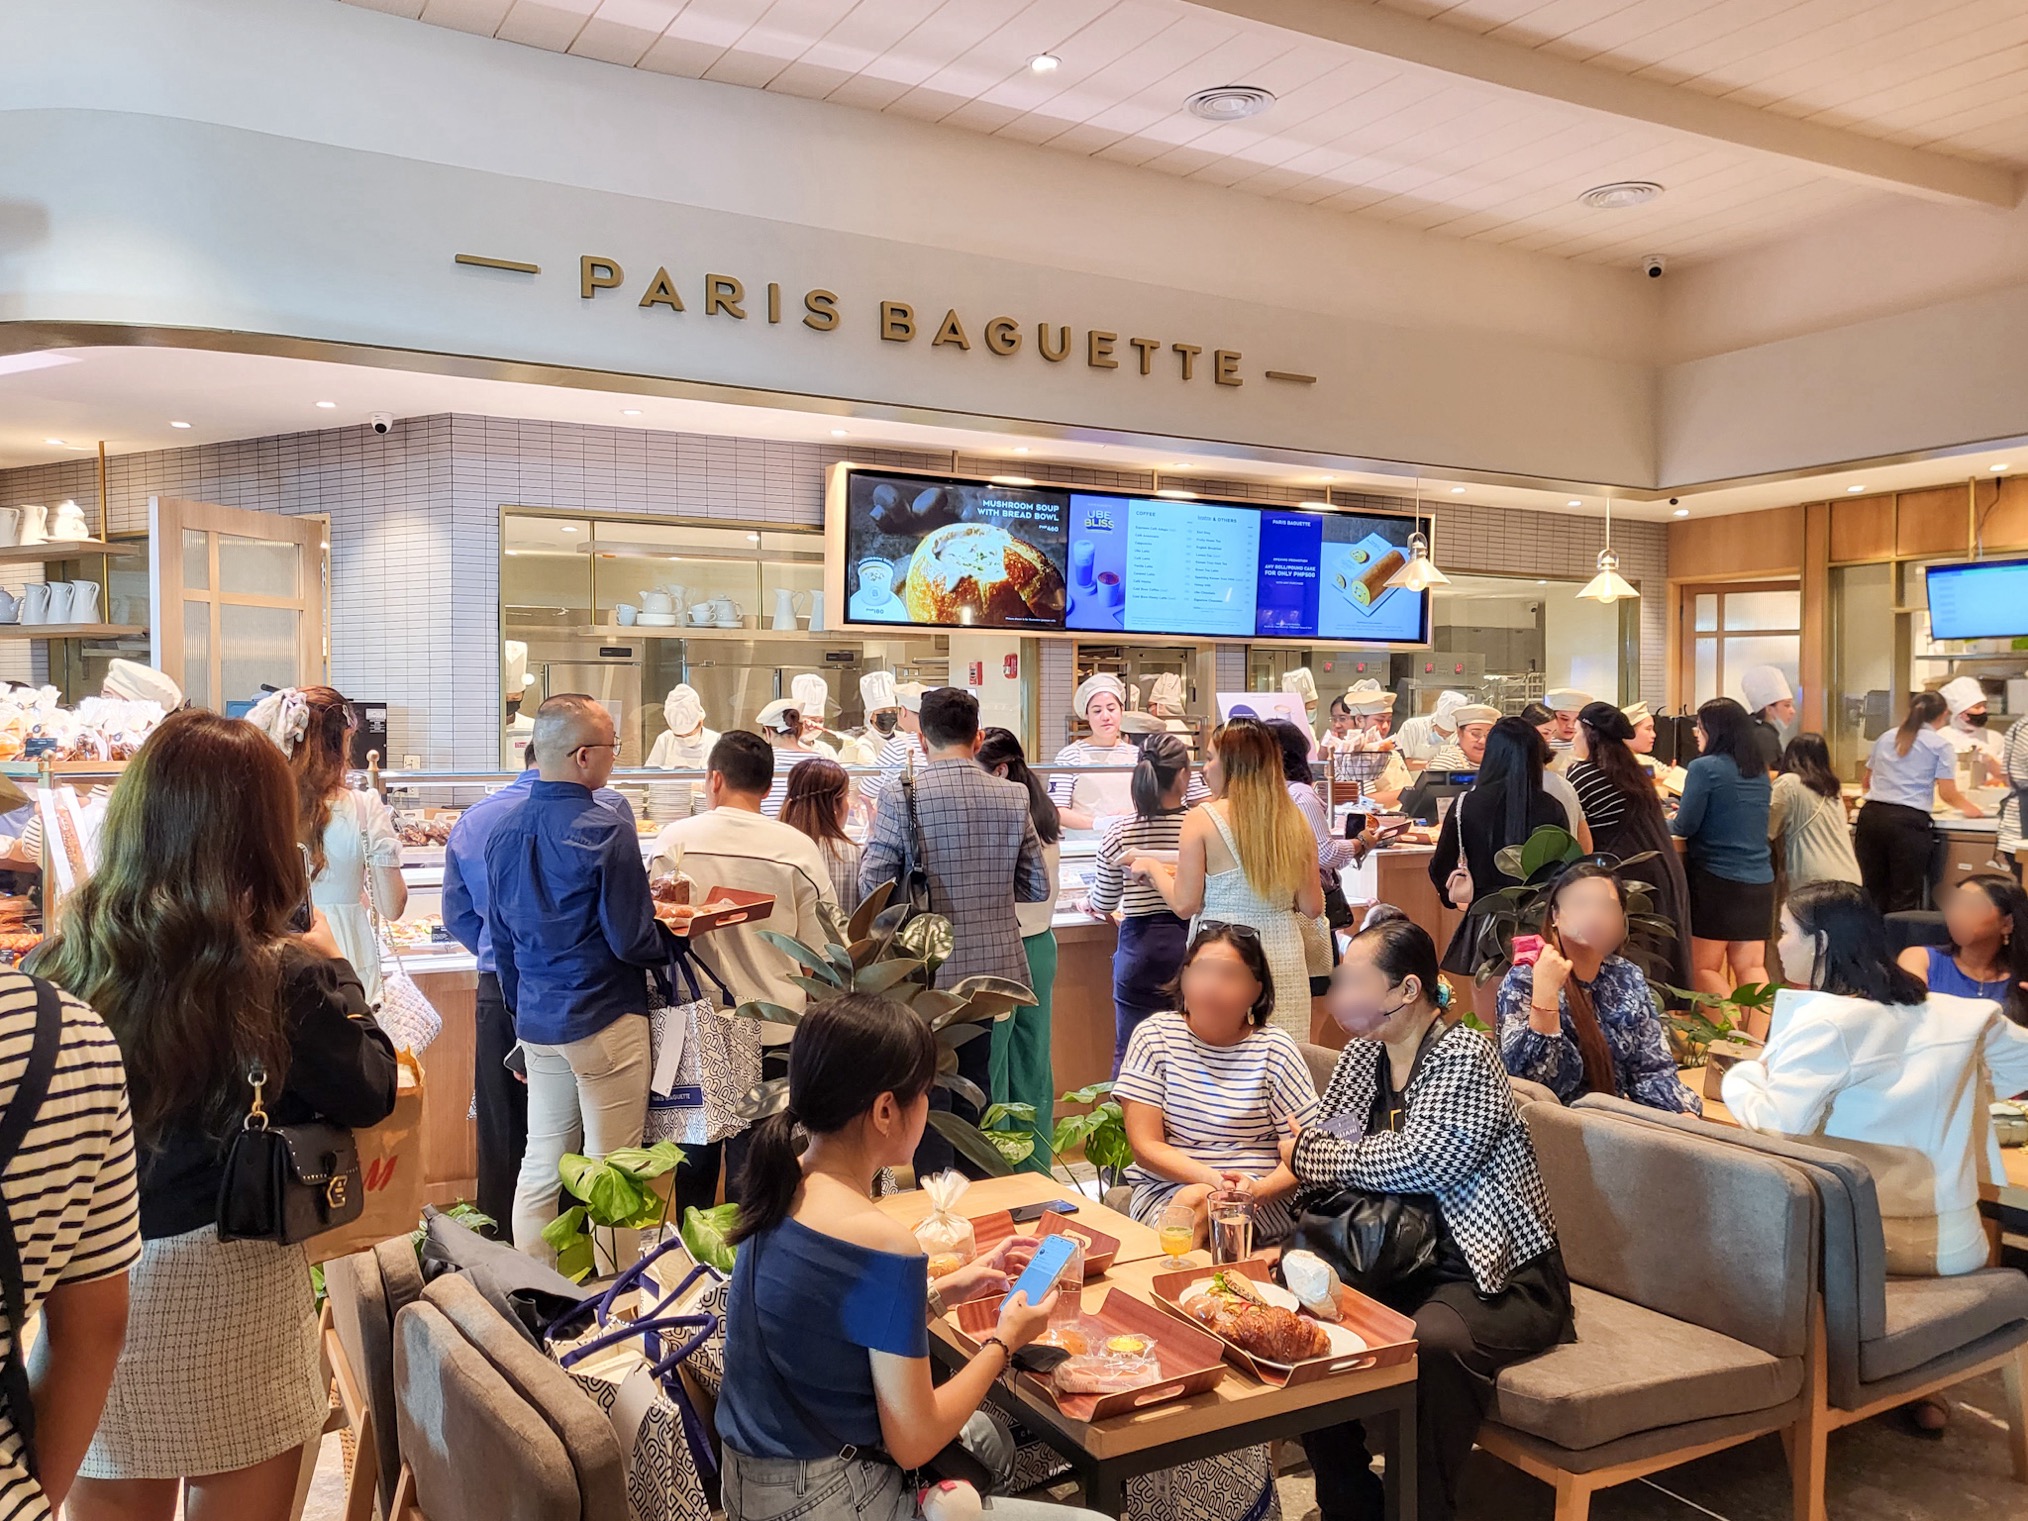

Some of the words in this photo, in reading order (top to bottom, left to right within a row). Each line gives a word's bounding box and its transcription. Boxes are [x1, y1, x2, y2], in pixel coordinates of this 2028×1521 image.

[580, 254, 841, 332] PARIS
[880, 300, 1243, 387] BAGUETTE
[983, 500, 1033, 510] MUSHROOM
[1036, 504, 1059, 512] SOUP
[977, 508, 999, 517] WITH
[1003, 510, 1032, 519] BREAD
[1035, 513, 1059, 521] BOWL
[1088, 510, 1112, 520] UBE
[1085, 519, 1114, 529] BLISS
